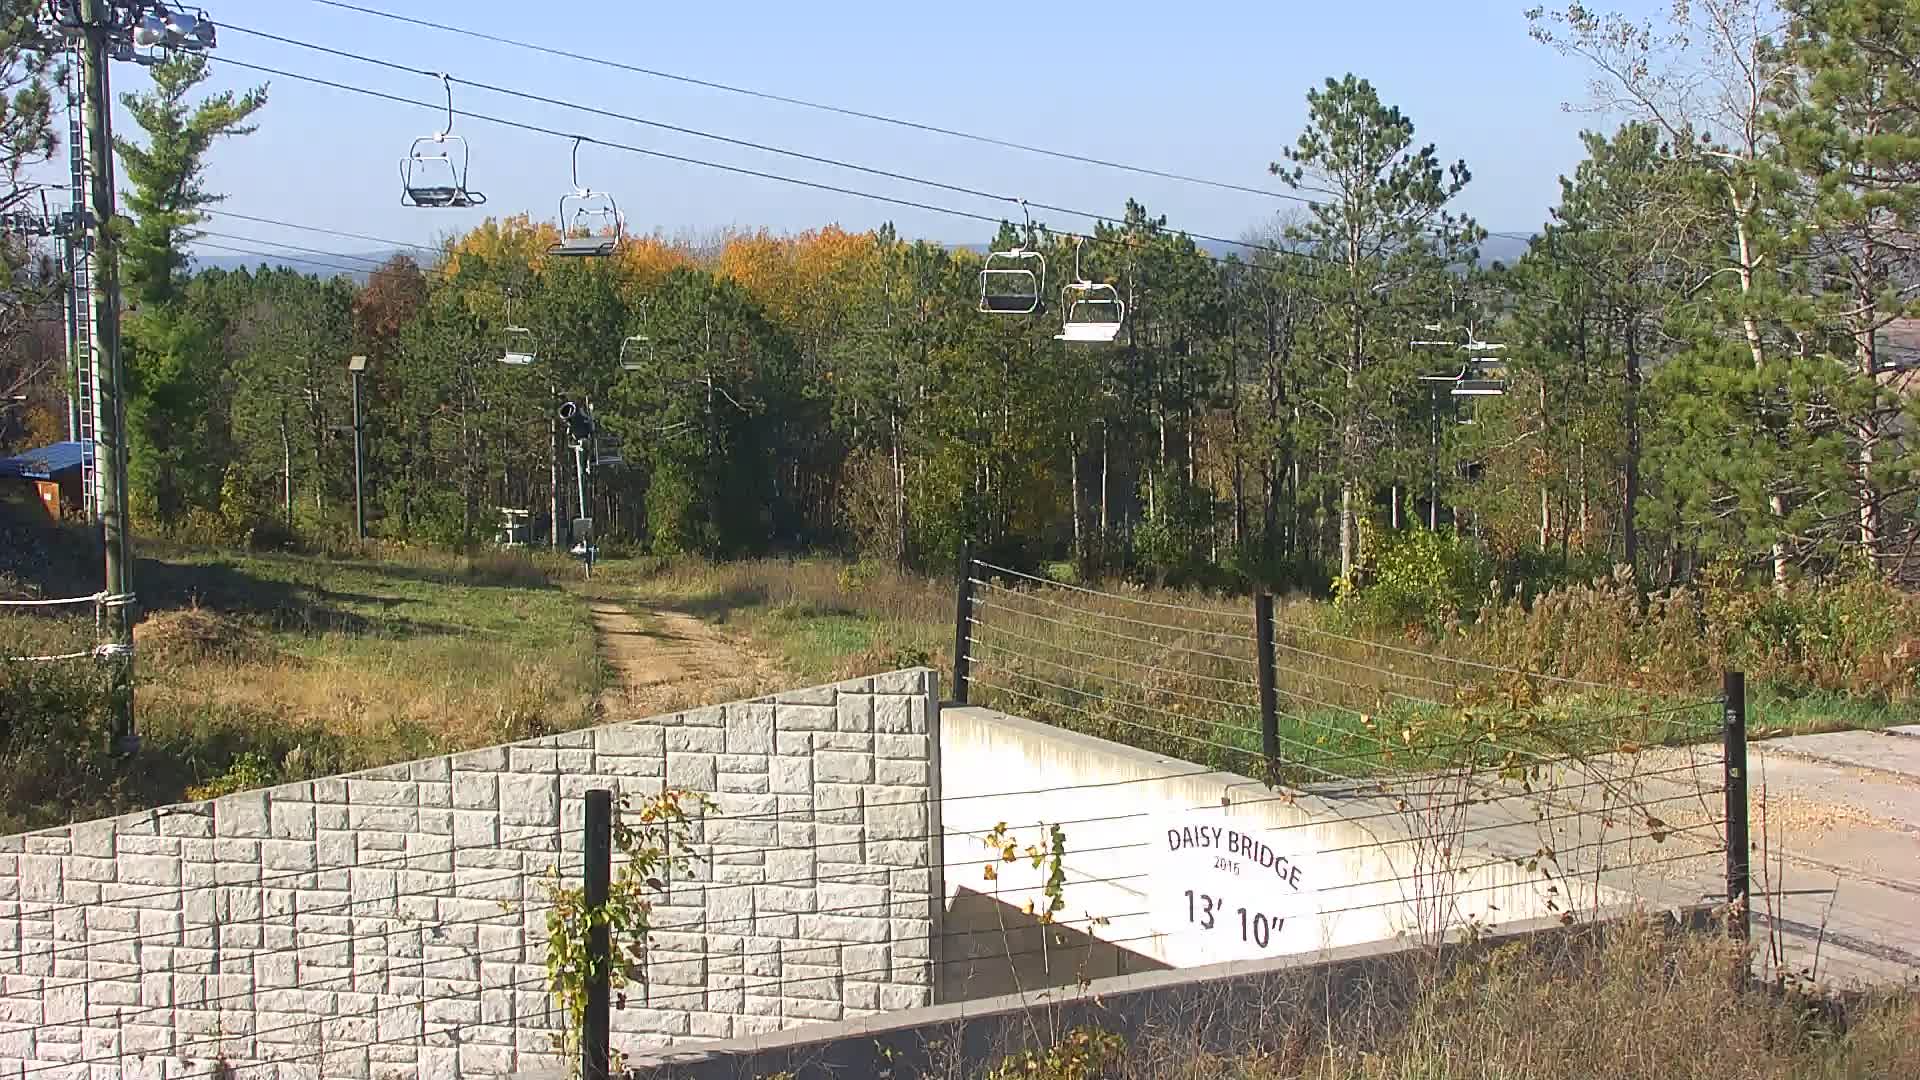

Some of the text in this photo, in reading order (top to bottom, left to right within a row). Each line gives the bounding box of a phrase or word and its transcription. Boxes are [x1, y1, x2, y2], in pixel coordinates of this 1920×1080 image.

[1167, 825, 1302, 891] DAISY BRIDGE
[1184, 889, 1223, 930] 13'
